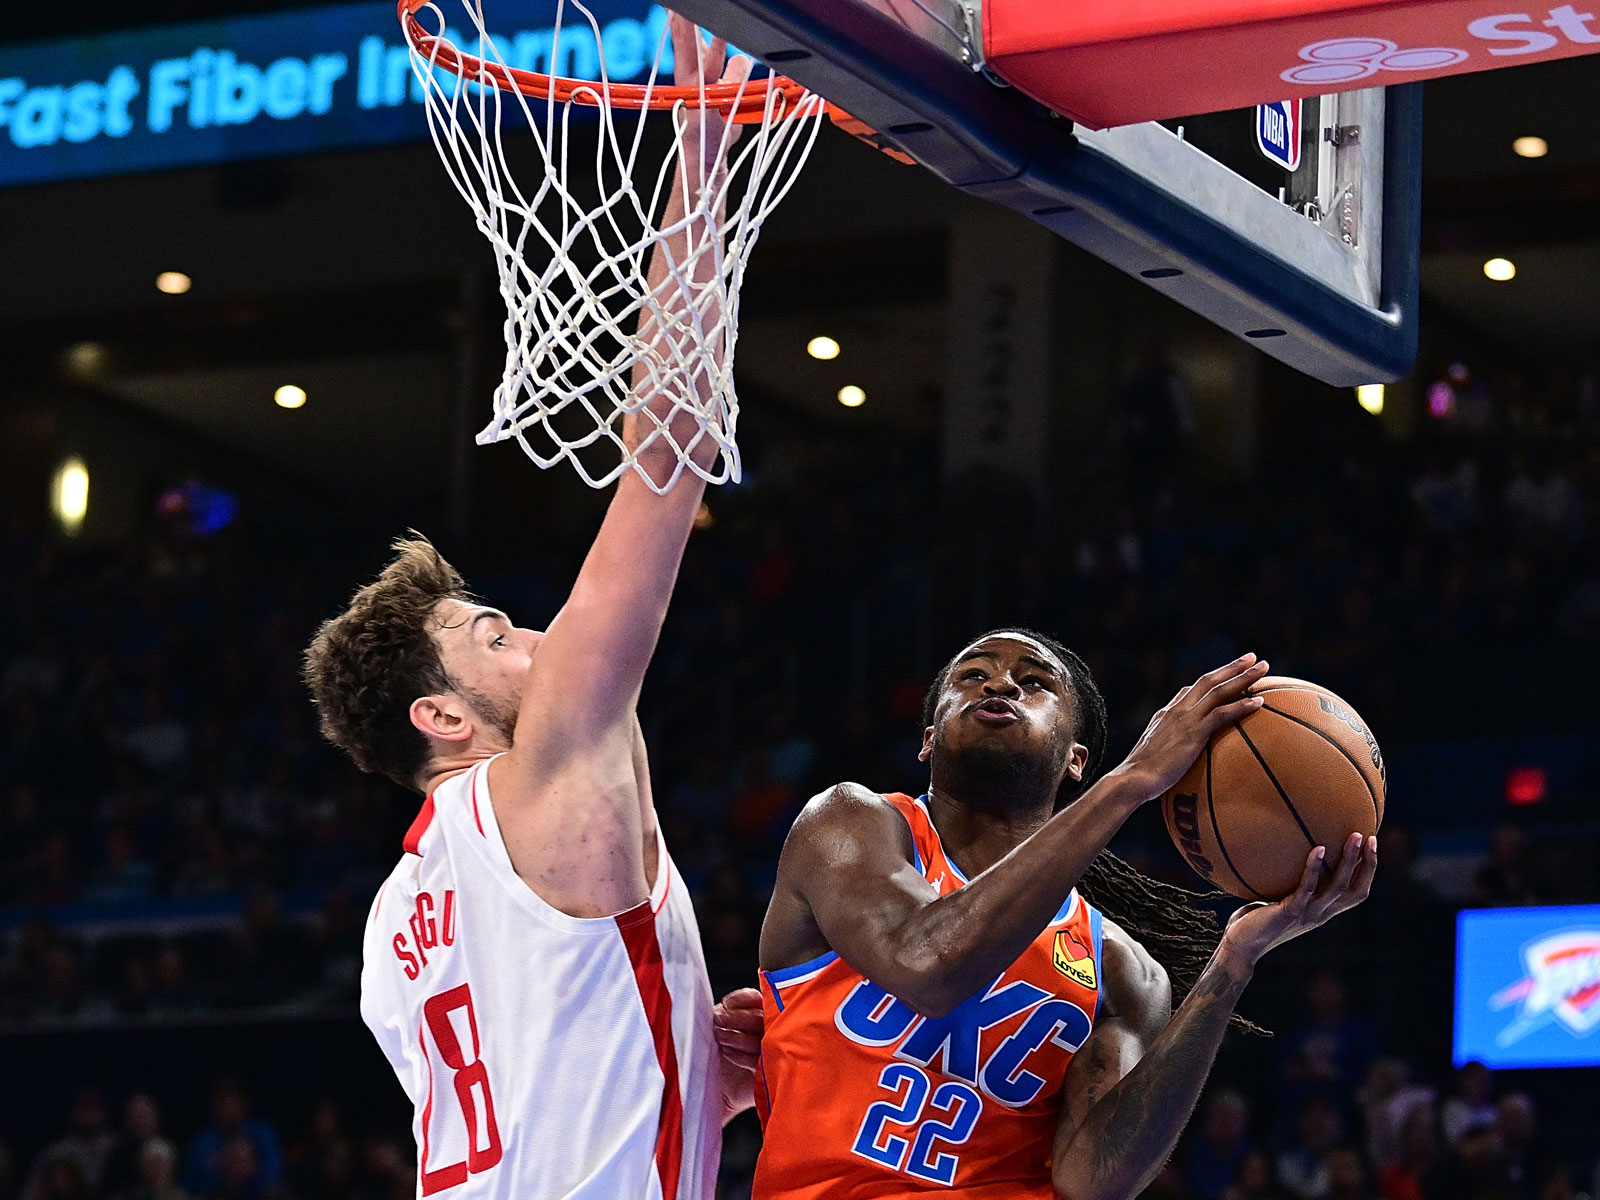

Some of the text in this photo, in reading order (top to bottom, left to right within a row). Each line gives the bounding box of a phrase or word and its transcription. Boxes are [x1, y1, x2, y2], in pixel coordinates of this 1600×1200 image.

[147, 46, 348, 133] Fiber
[1263, 103, 1285, 150] NBA
[834, 971, 1093, 1108] OKC
[851, 1062, 983, 1187] 22
